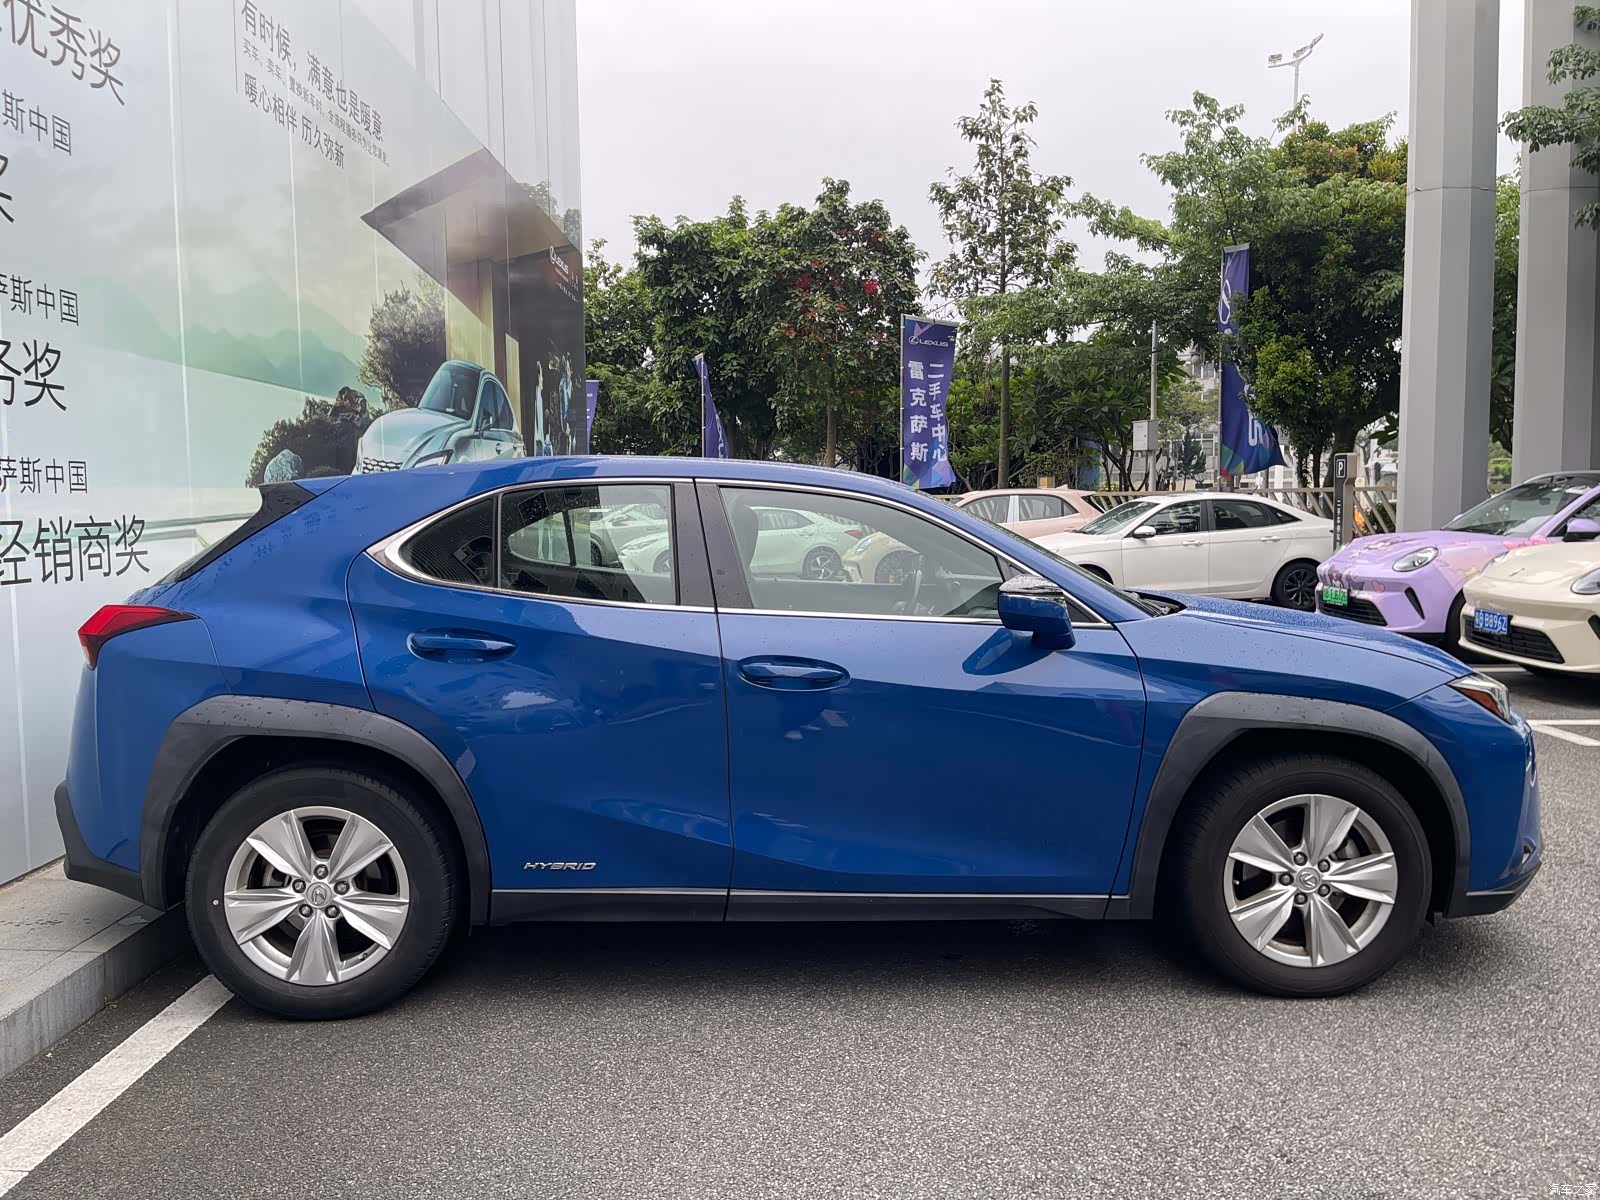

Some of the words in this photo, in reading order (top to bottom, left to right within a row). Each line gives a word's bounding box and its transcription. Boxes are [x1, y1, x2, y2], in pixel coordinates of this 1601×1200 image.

[2, 89, 72, 156] 斯中国
[244, 72, 297, 134] 暖心相伴
[302, 115, 345, 169] 历久弥新
[919, 338, 949, 348] LEXUS
[908, 361, 929, 463] 雷克萨斯
[928, 363, 948, 462] 二手车中心
[1338, 461, 1344, 476] P
[0, 514, 150, 585] 经销商奖
[523, 862, 597, 870] HYBRID
